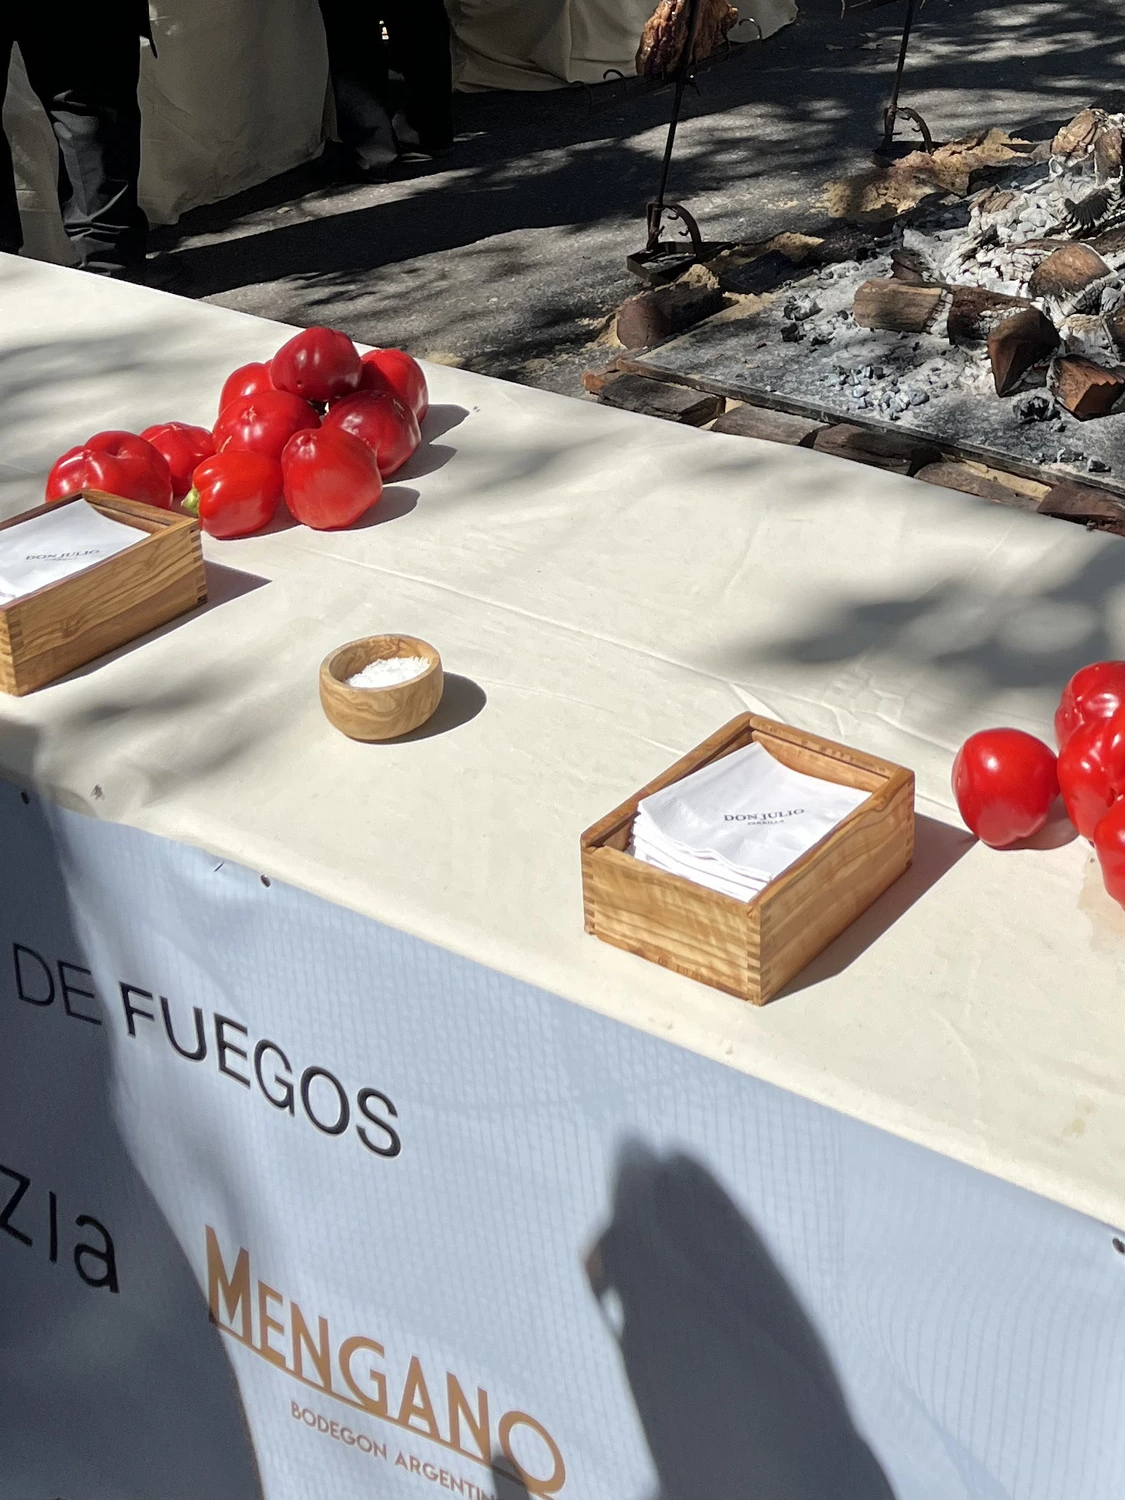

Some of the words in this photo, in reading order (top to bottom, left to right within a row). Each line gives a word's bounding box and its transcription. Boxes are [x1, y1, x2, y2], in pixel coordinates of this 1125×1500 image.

[724, 813, 758, 821] DON
[760, 808, 805, 820] JULIO
[12, 942, 102, 1026] DE
[118, 980, 402, 1159] FUEGOS
[204, 1223, 567, 1496] MENGANO
[290, 1400, 388, 1461] BODEGON
